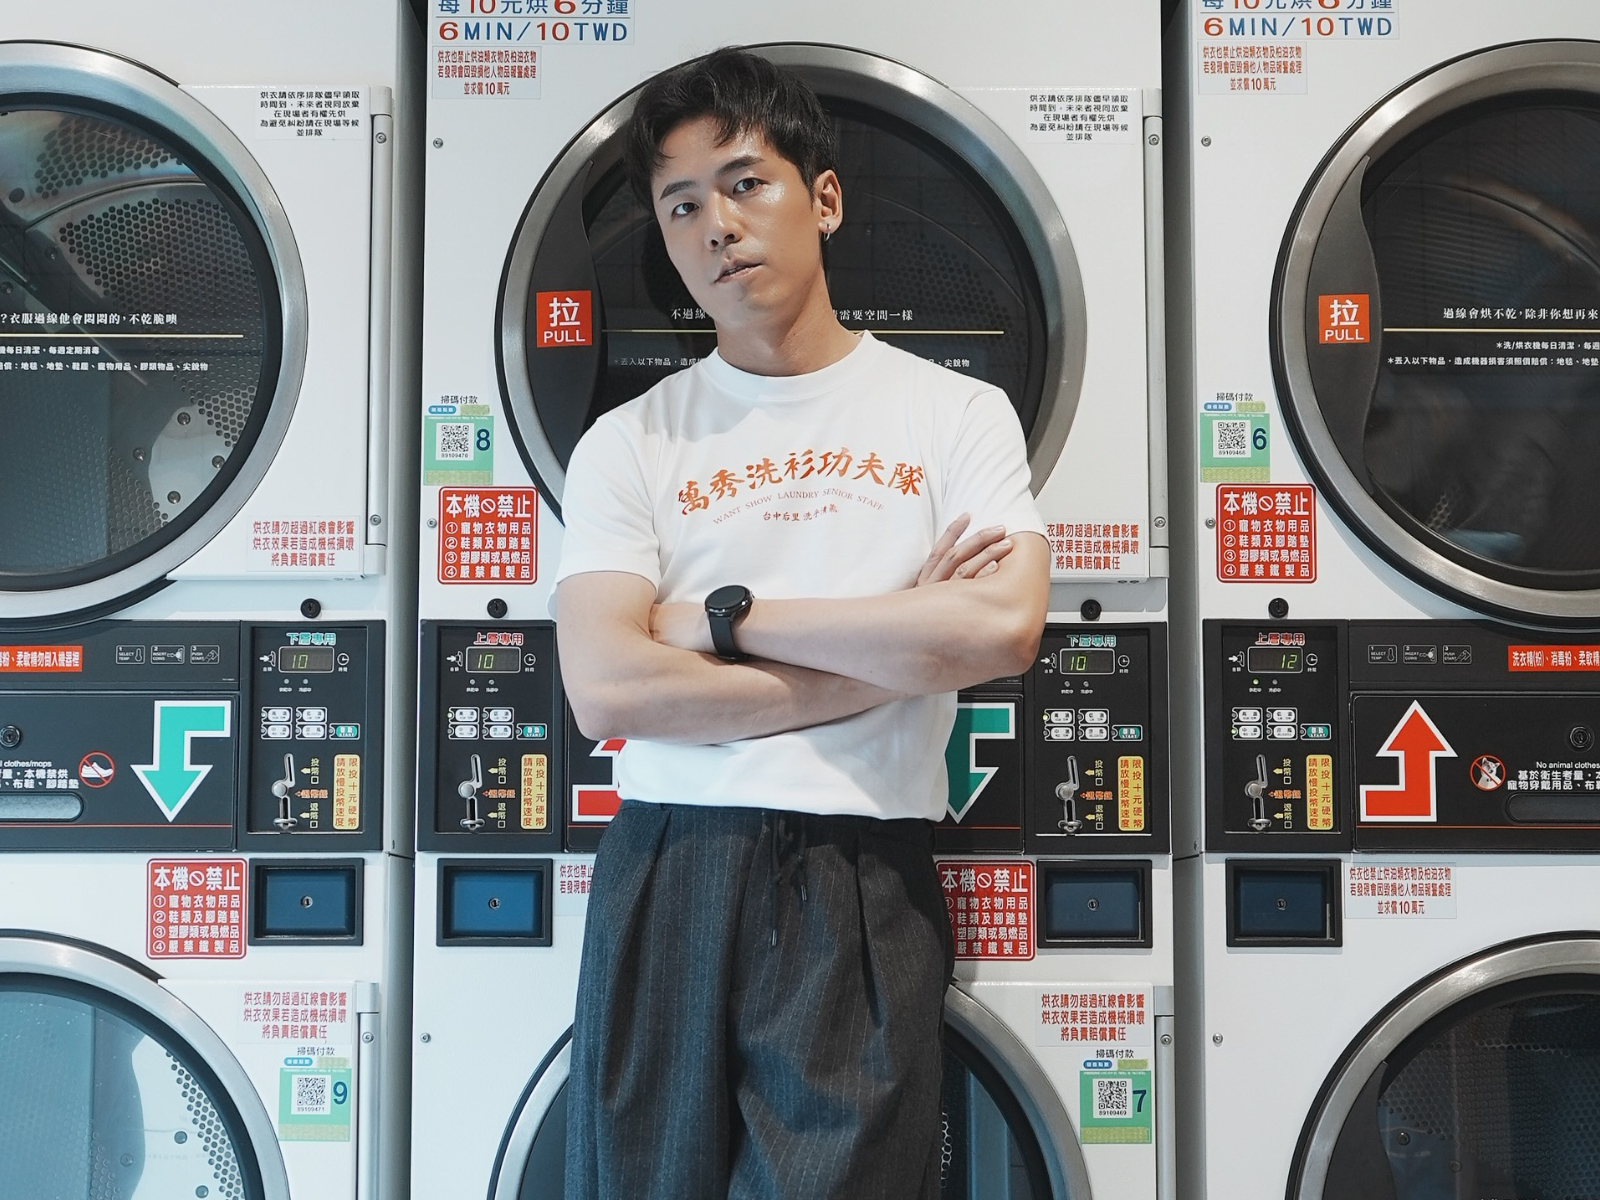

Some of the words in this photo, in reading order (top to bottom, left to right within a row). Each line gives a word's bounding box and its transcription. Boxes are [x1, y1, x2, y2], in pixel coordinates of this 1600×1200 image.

[549, 297, 580, 327] 拉
[1330, 299, 1359, 326] 拉
[544, 330, 586, 343] PULL
[1325, 329, 1364, 341] PULL
[441, 395, 478, 404] 掃碼付款
[1216, 392, 1254, 401] 掃碼付款
[476, 428, 490, 451] 8
[1253, 428, 1267, 450] 6
[678, 447, 924, 516] 萬秀洗衫功夫隊
[446, 494, 480, 518] 本機
[497, 494, 531, 518] 禁止
[714, 508, 741, 525] WANT
[745, 494, 772, 510] SHOW
[778, 490, 818, 500] LAUNDRY
[822, 488, 853, 500] SENIOR
[857, 495, 884, 511] STAFF
[1224, 491, 1258, 516] 本機
[1275, 491, 1309, 516] 禁止
[763, 512, 800, 521] 台中后里
[1056, 556, 1120, 570] 將負責賠償責任
[292, 654, 308, 668] 10
[478, 654, 494, 668] 10
[1070, 656, 1086, 671] 10
[1282, 654, 1297, 668] 12
[0, 769, 68, 779] 量，本機禁烘
[1549, 761, 1573, 769] animal
[1574, 761, 1600, 769] clothes
[0, 779, 79, 789] 、布鞋、腳踏墊
[348, 758, 357, 826] 限投十元硬幣
[536, 758, 544, 826] 限投十元硬幣
[1321, 758, 1331, 827] 限投十元硬幣
[1132, 759, 1142, 828] 限投十元硬幣
[154, 866, 189, 890] 本機
[206, 866, 240, 890] 禁止
[941, 868, 976, 893] 本機
[994, 868, 1028, 893] 禁止
[1061, 1027, 1126, 1042] 將負責賠償責任
[297, 1047, 335, 1056] 掃碼付款
[1096, 1049, 1134, 1059] 掃碼付款
[333, 1081, 348, 1105] 9
[1132, 1090, 1147, 1112] 7
